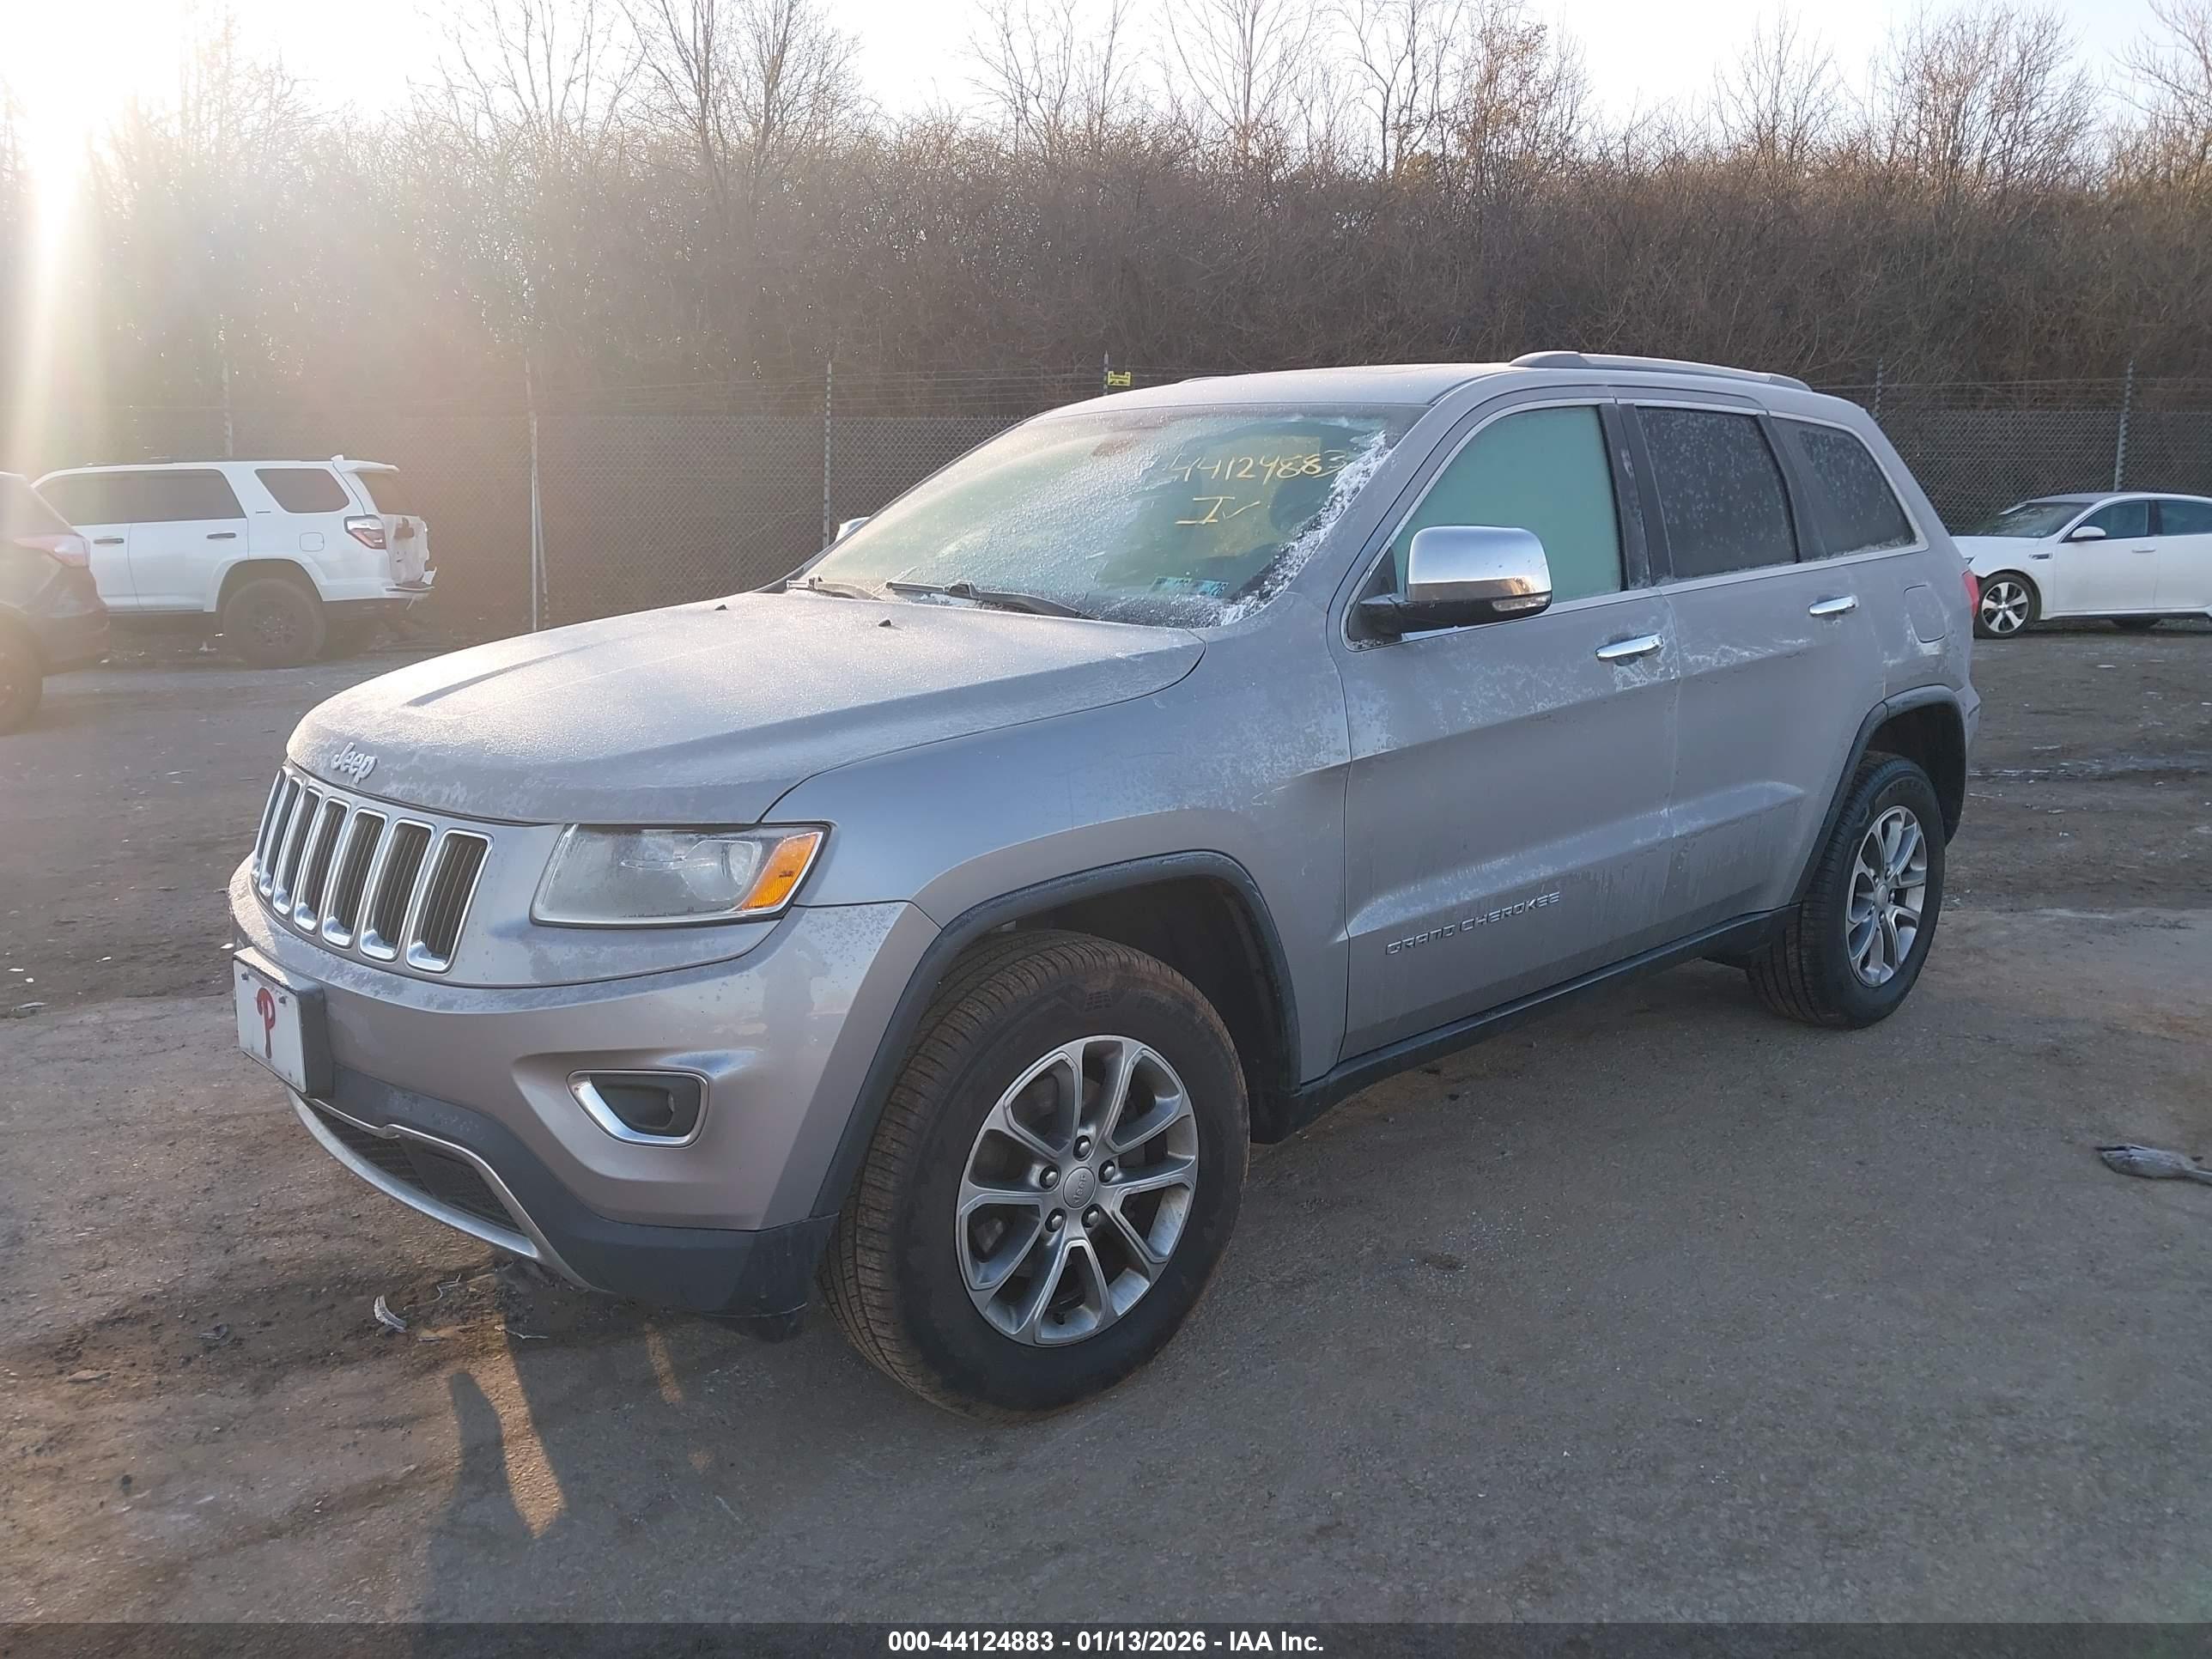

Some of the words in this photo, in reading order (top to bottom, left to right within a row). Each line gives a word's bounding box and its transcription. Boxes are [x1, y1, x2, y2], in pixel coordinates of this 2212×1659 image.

[1170, 449, 1348, 486] 44124883
[330, 741, 378, 784] Jeep
[1385, 924, 1457, 956] GRAND
[1459, 890, 1561, 933] CHEROKEE
